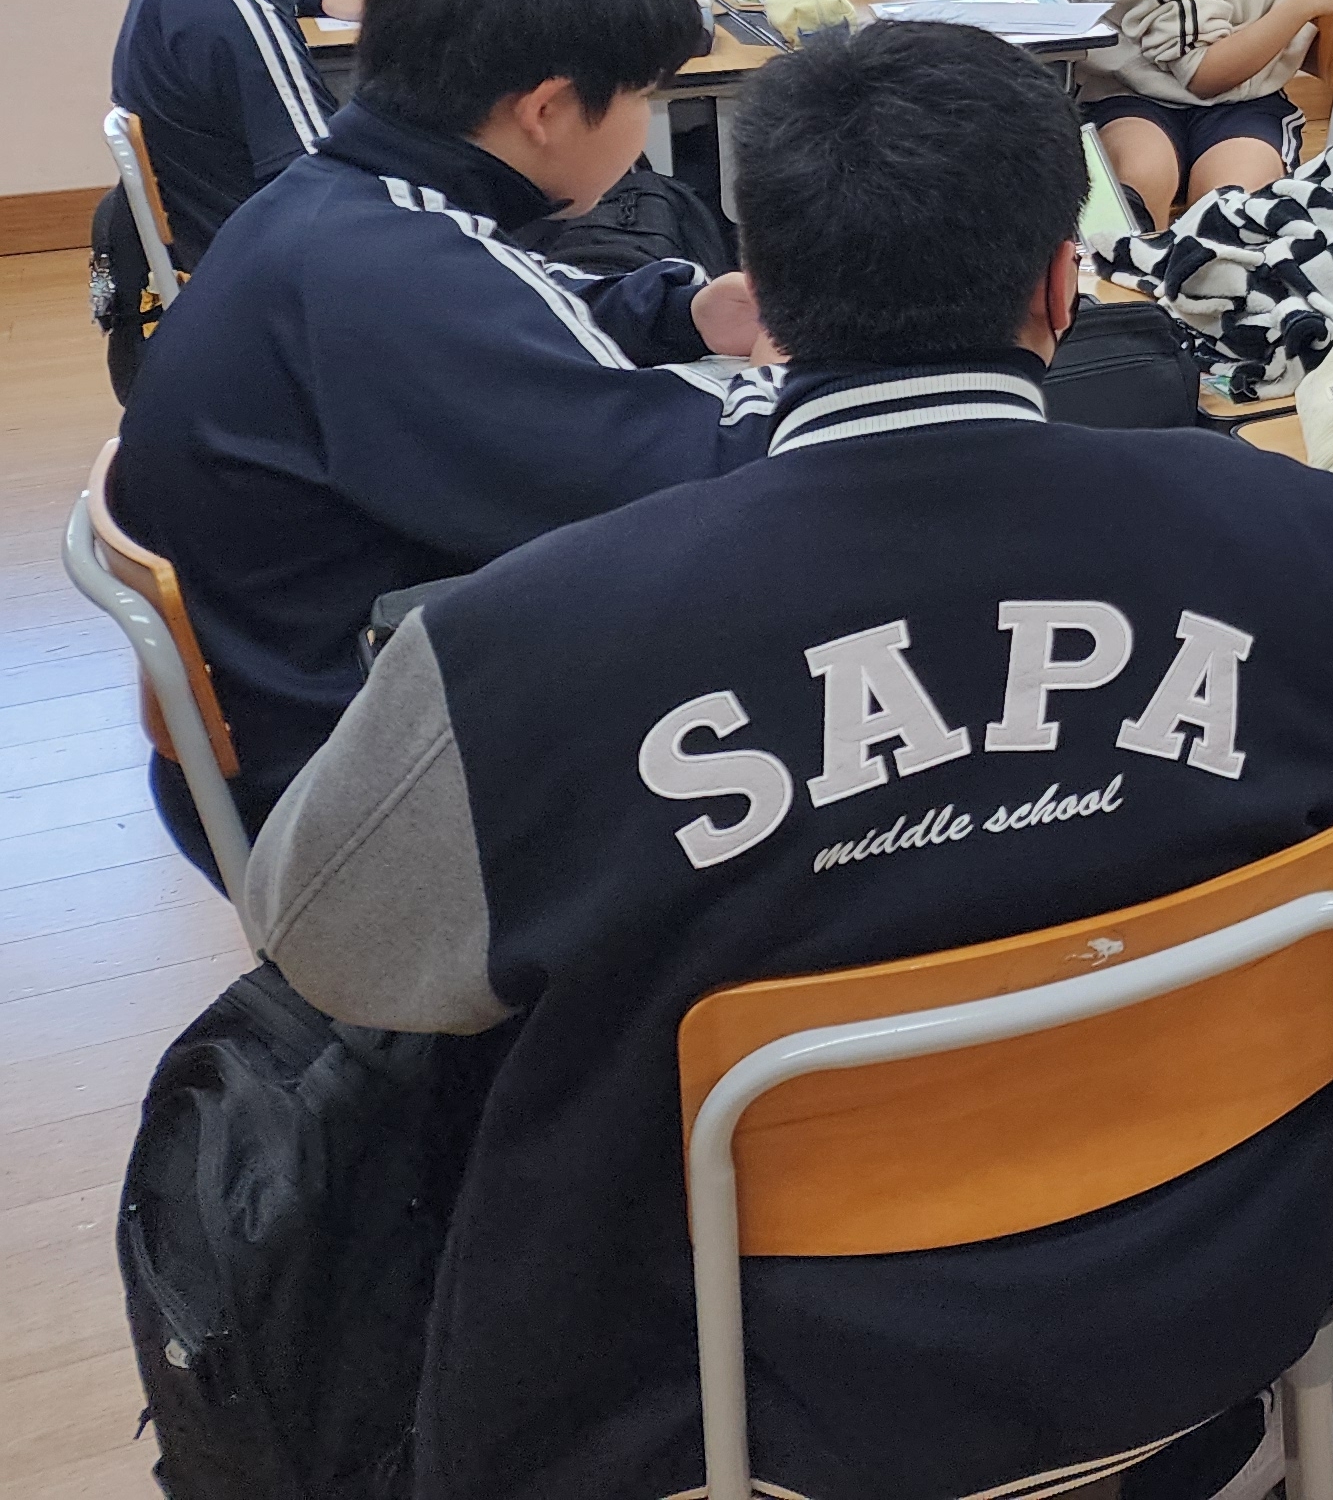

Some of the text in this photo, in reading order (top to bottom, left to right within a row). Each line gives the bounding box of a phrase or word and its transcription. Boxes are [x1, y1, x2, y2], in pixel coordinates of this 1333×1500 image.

[637, 599, 1254, 869] SAPA
[812, 772, 1125, 874] middle school
